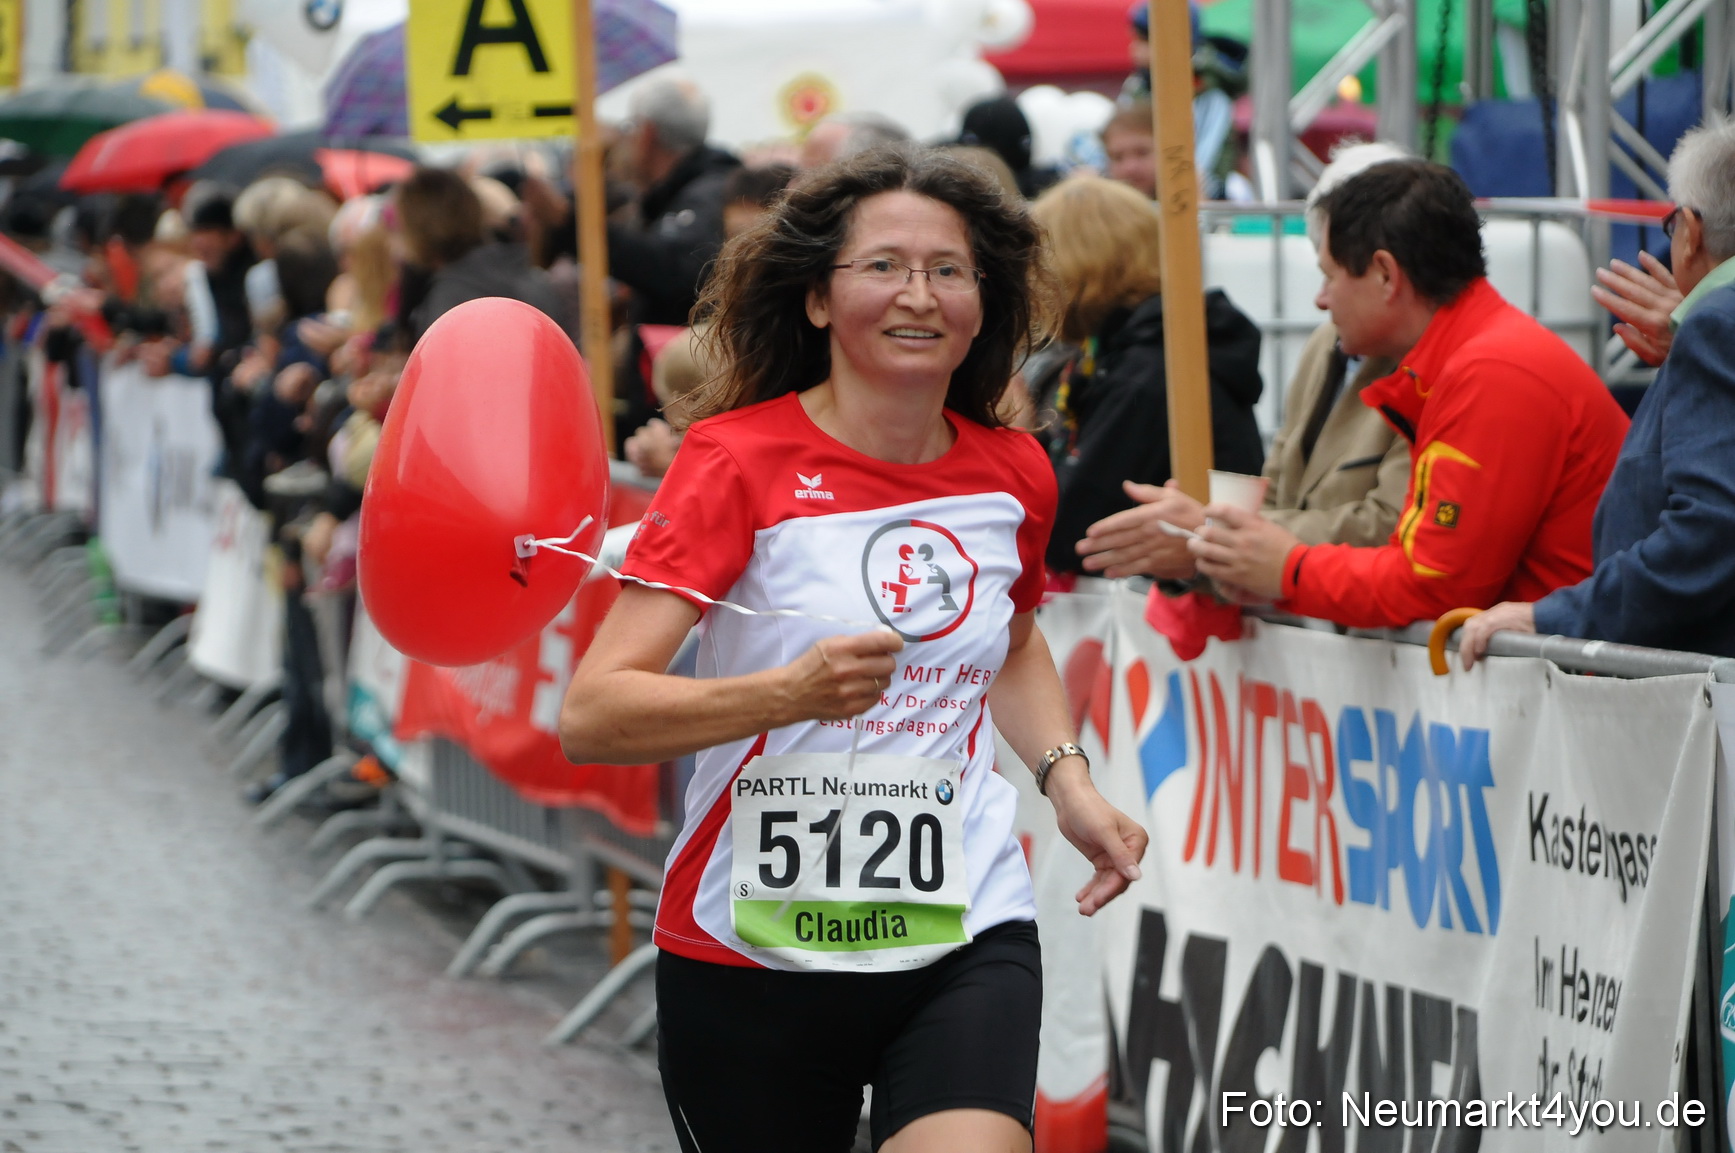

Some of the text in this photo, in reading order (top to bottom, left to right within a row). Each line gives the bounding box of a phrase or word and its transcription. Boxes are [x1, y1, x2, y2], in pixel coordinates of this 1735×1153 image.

[451, 0, 552, 75] A
[794, 487, 835, 500] erima
[903, 664, 997, 686] MIT HER
[737, 777, 815, 797] PARTL
[822, 777, 928, 799] Neumarkt
[758, 809, 944, 893] 5120
[795, 909, 908, 943] Claudia
